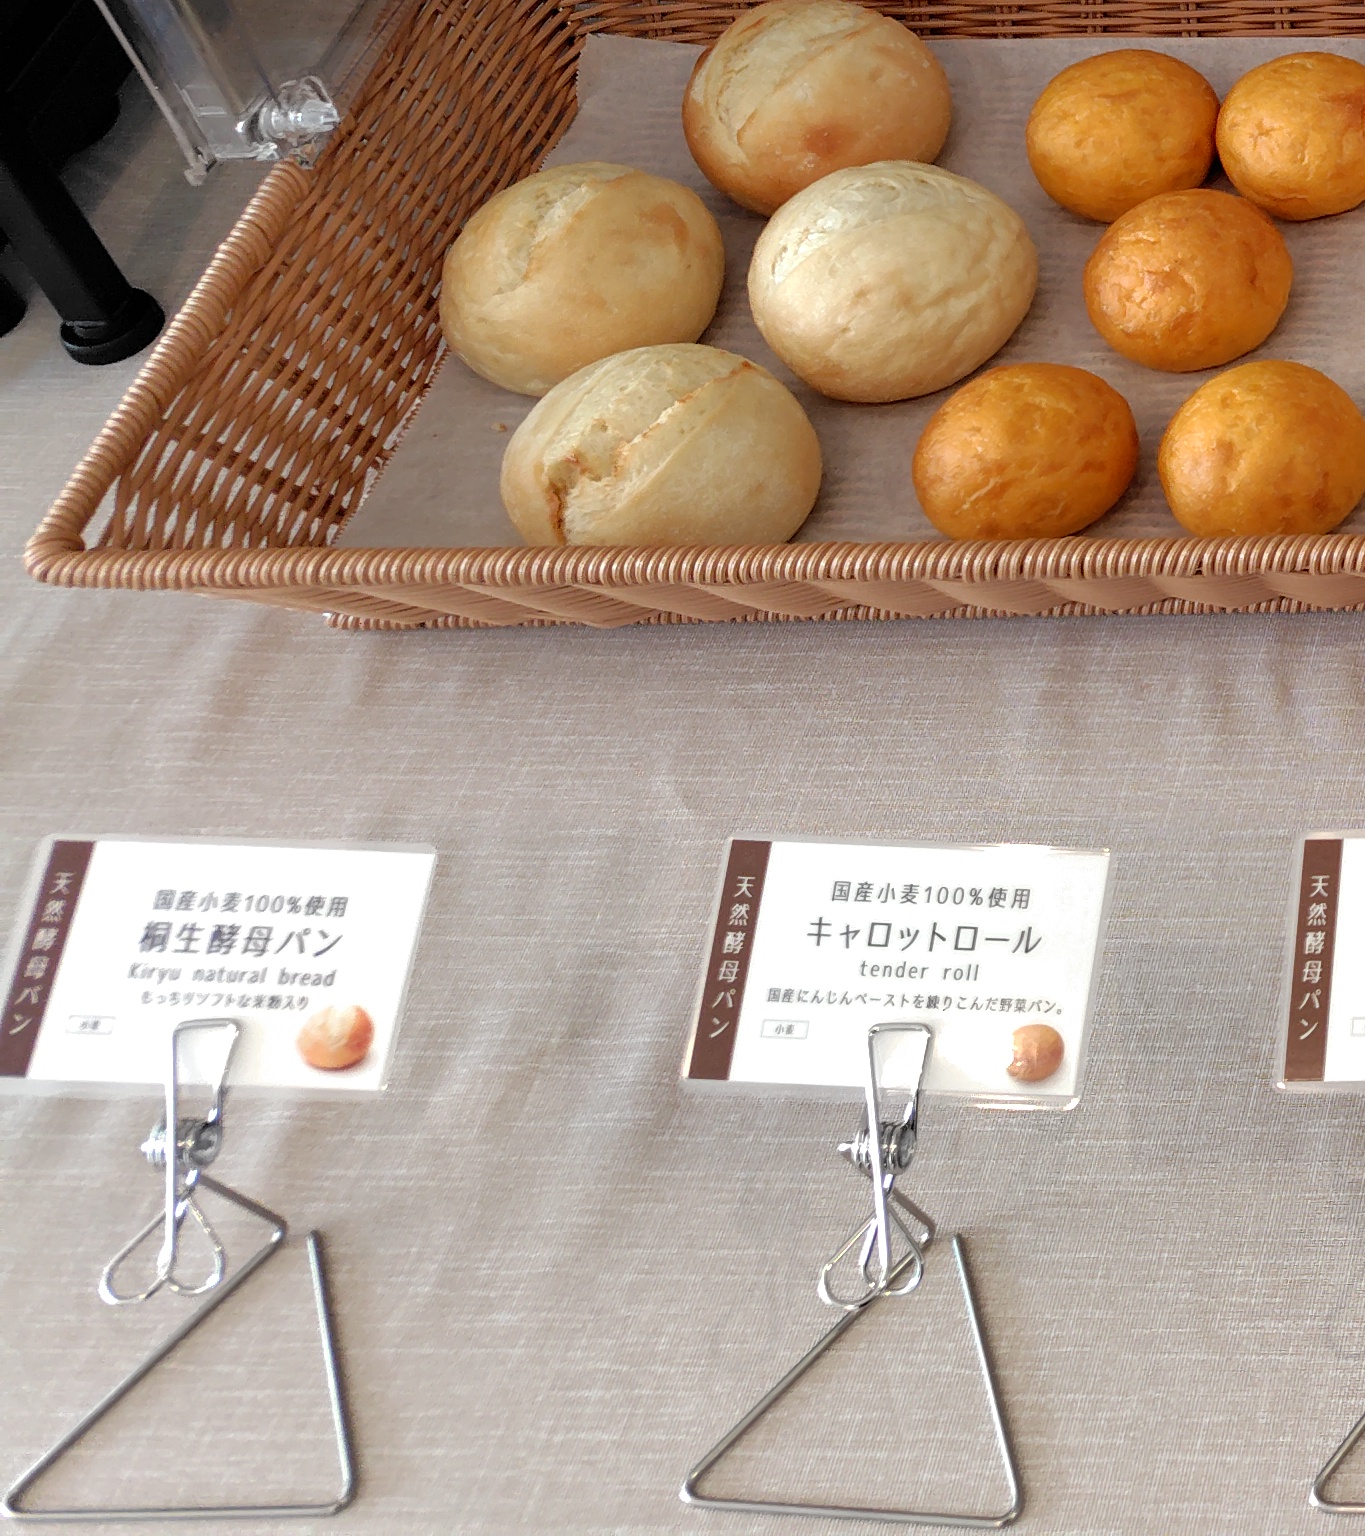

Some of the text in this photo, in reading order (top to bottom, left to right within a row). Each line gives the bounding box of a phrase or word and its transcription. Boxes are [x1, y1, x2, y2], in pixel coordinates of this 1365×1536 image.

[152, 889, 349, 918] 国産小麦100%使用
[831, 880, 1031, 909] 国産小麦100%使用
[9, 871, 77, 1036] 天然酵母パン
[138, 920, 343, 958] 桐生酵母パン
[806, 916, 1043, 955] キャロットロール
[127, 962, 338, 987] Kiryu natural bread
[708, 876, 756, 1039] 天然酵母パン
[859, 961, 979, 981] tender roll
[1299, 875, 1331, 1040] 天然酵母パン
